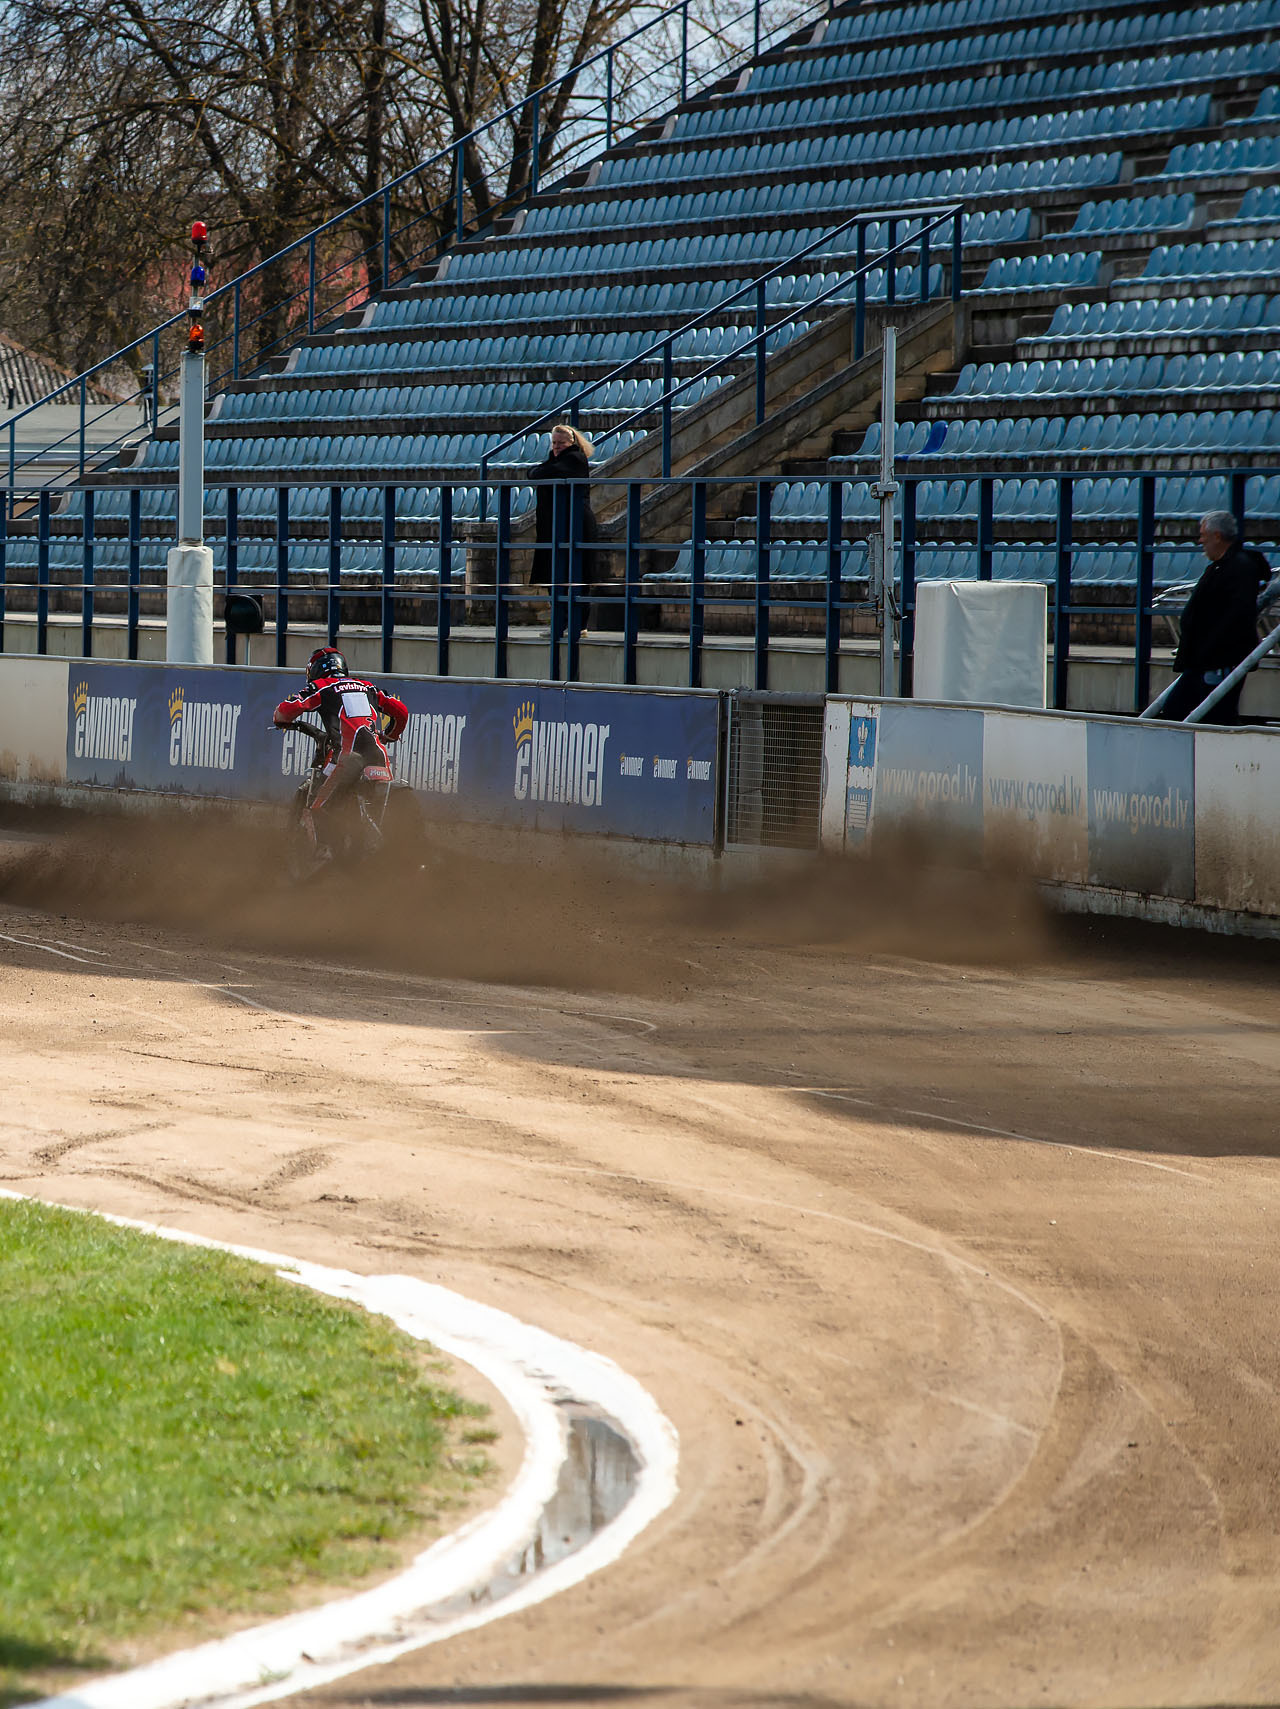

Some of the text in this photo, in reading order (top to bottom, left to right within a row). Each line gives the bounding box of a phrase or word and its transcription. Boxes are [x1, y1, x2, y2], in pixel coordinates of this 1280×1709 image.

[333, 682, 369, 693] Levishyn
[74, 695, 137, 762] ewinner
[170, 701, 241, 770] ewinner
[514, 720, 610, 807] ewinner
[882, 763, 977, 809] www.gorod.lv
[989, 774, 1082, 821] www.gorod.lv
[1093, 786, 1189, 835] www.gorod.lv
